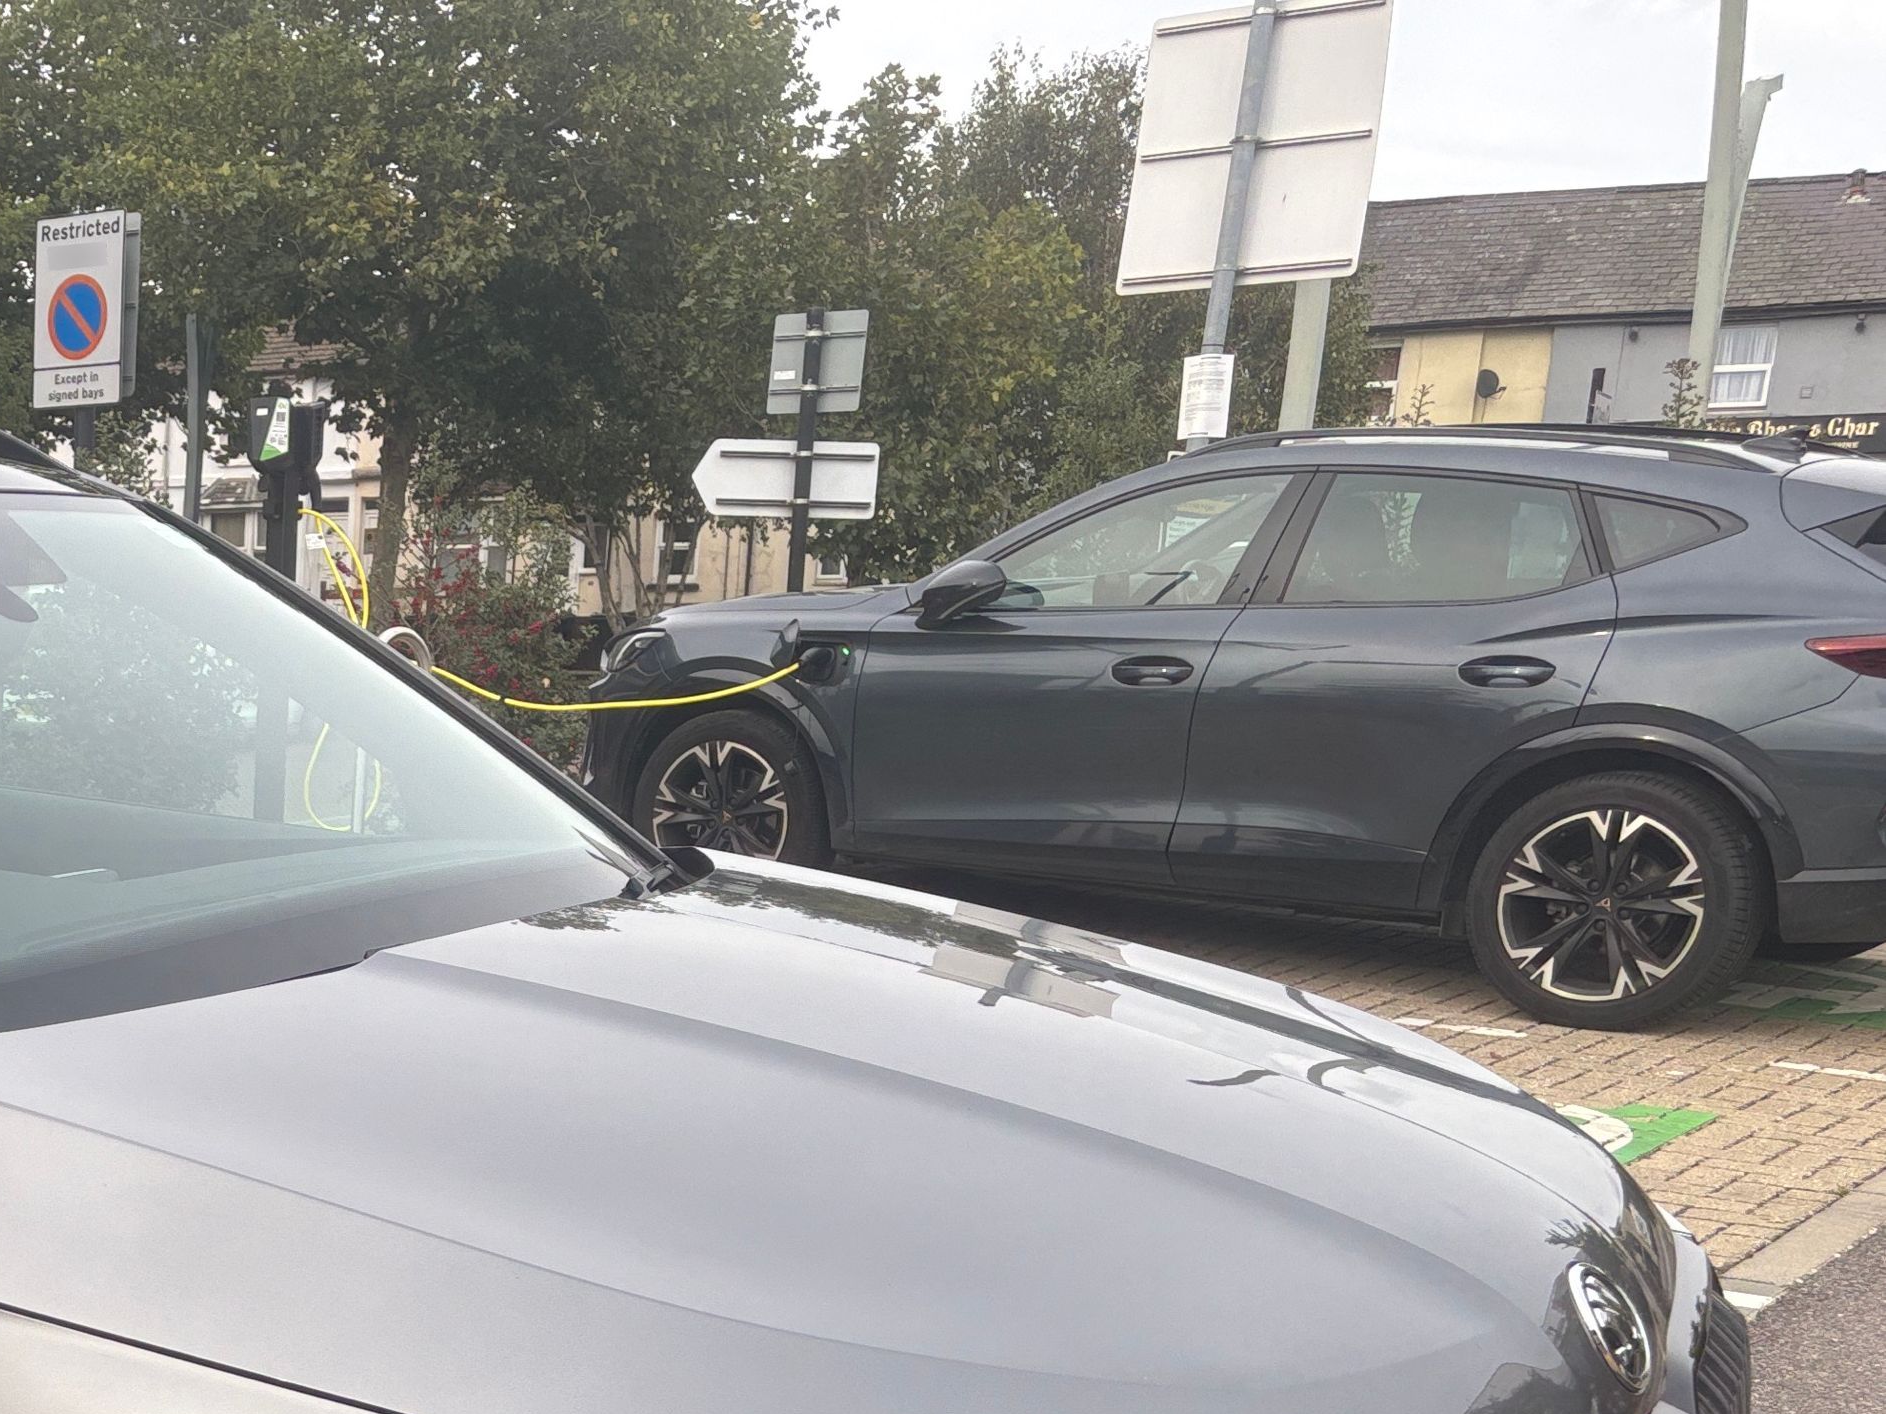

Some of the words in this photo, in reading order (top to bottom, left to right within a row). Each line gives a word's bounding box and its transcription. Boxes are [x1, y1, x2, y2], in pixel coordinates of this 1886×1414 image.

[41, 216, 120, 242] Restricted
[54, 371, 88, 385] Except
[89, 371, 99, 382] in
[48, 387, 79, 402] signed
[81, 387, 104, 400] bays
[1827, 416, 1881, 440] Ghar
